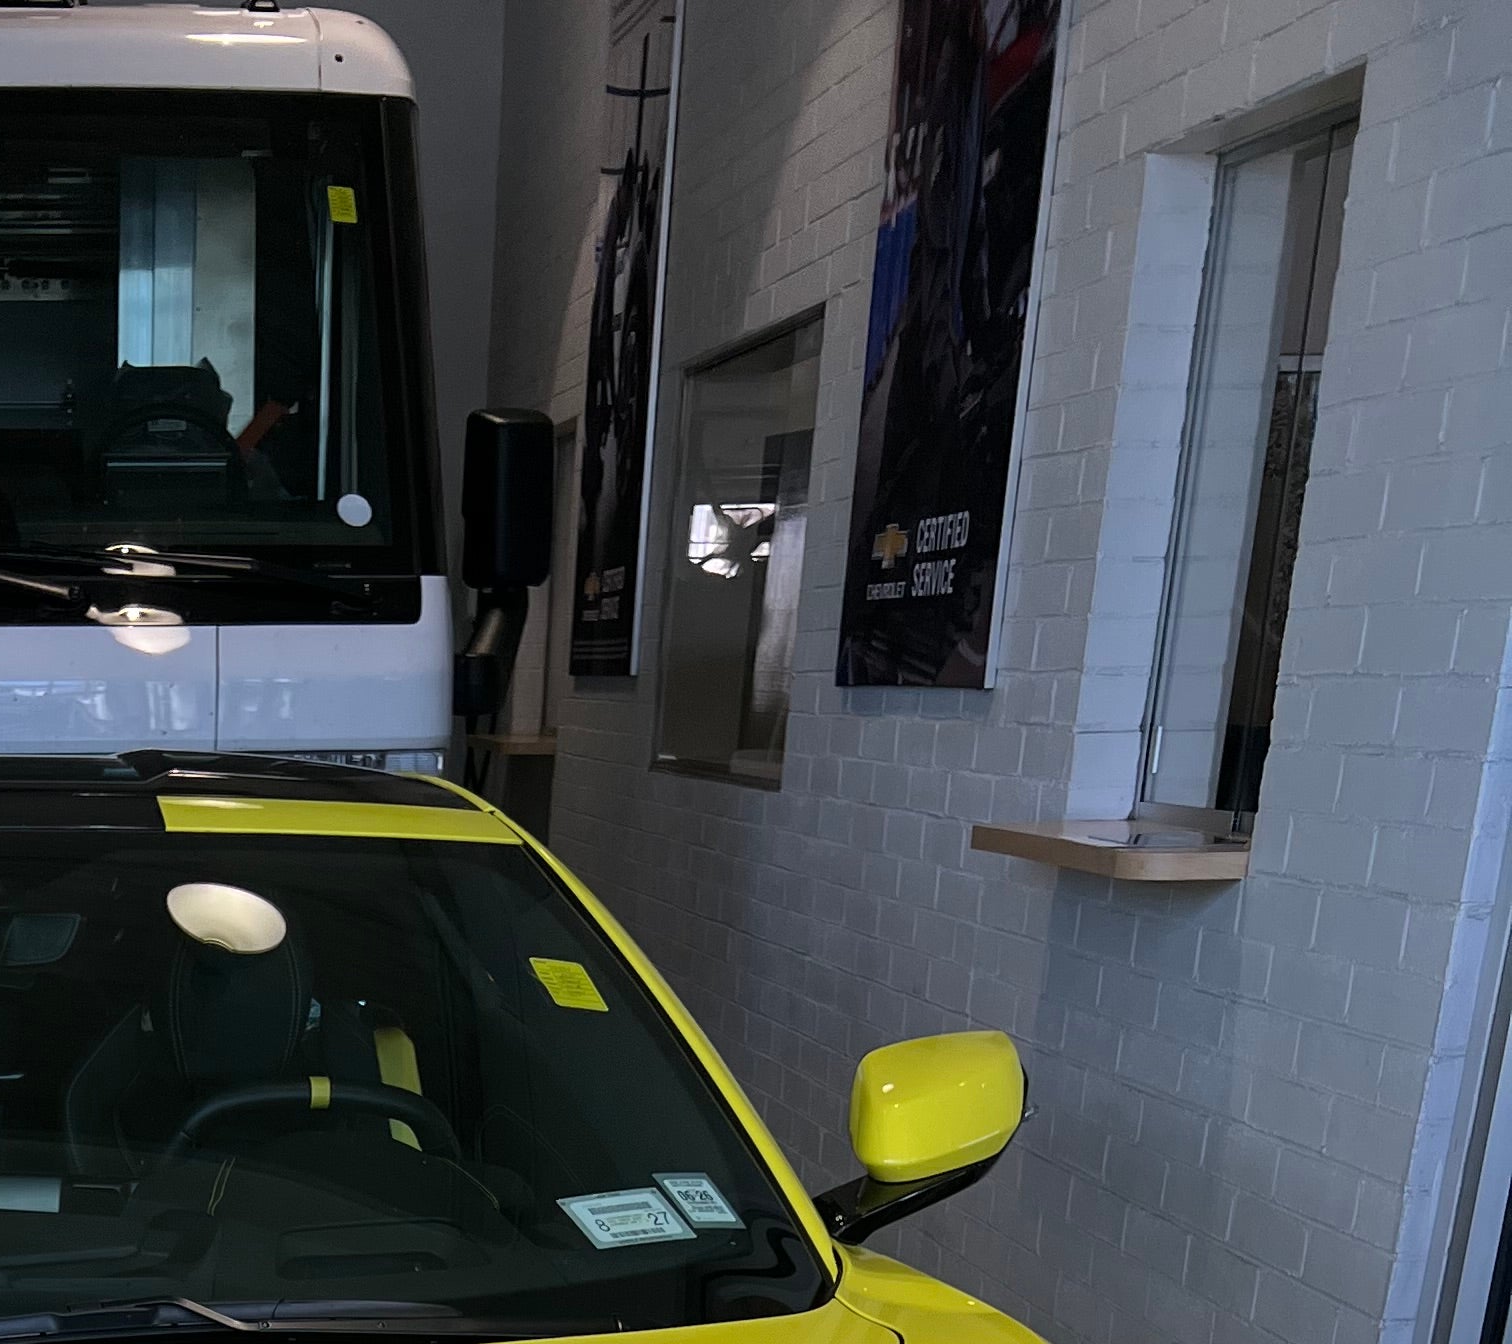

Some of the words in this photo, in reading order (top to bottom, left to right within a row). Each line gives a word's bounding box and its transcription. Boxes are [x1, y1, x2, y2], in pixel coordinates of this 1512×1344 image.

[916, 510, 970, 554] CERTIFIED
[911, 558, 957, 597] SERVICE
[595, 1219, 610, 1232] 8
[647, 1211, 670, 1226] 27
